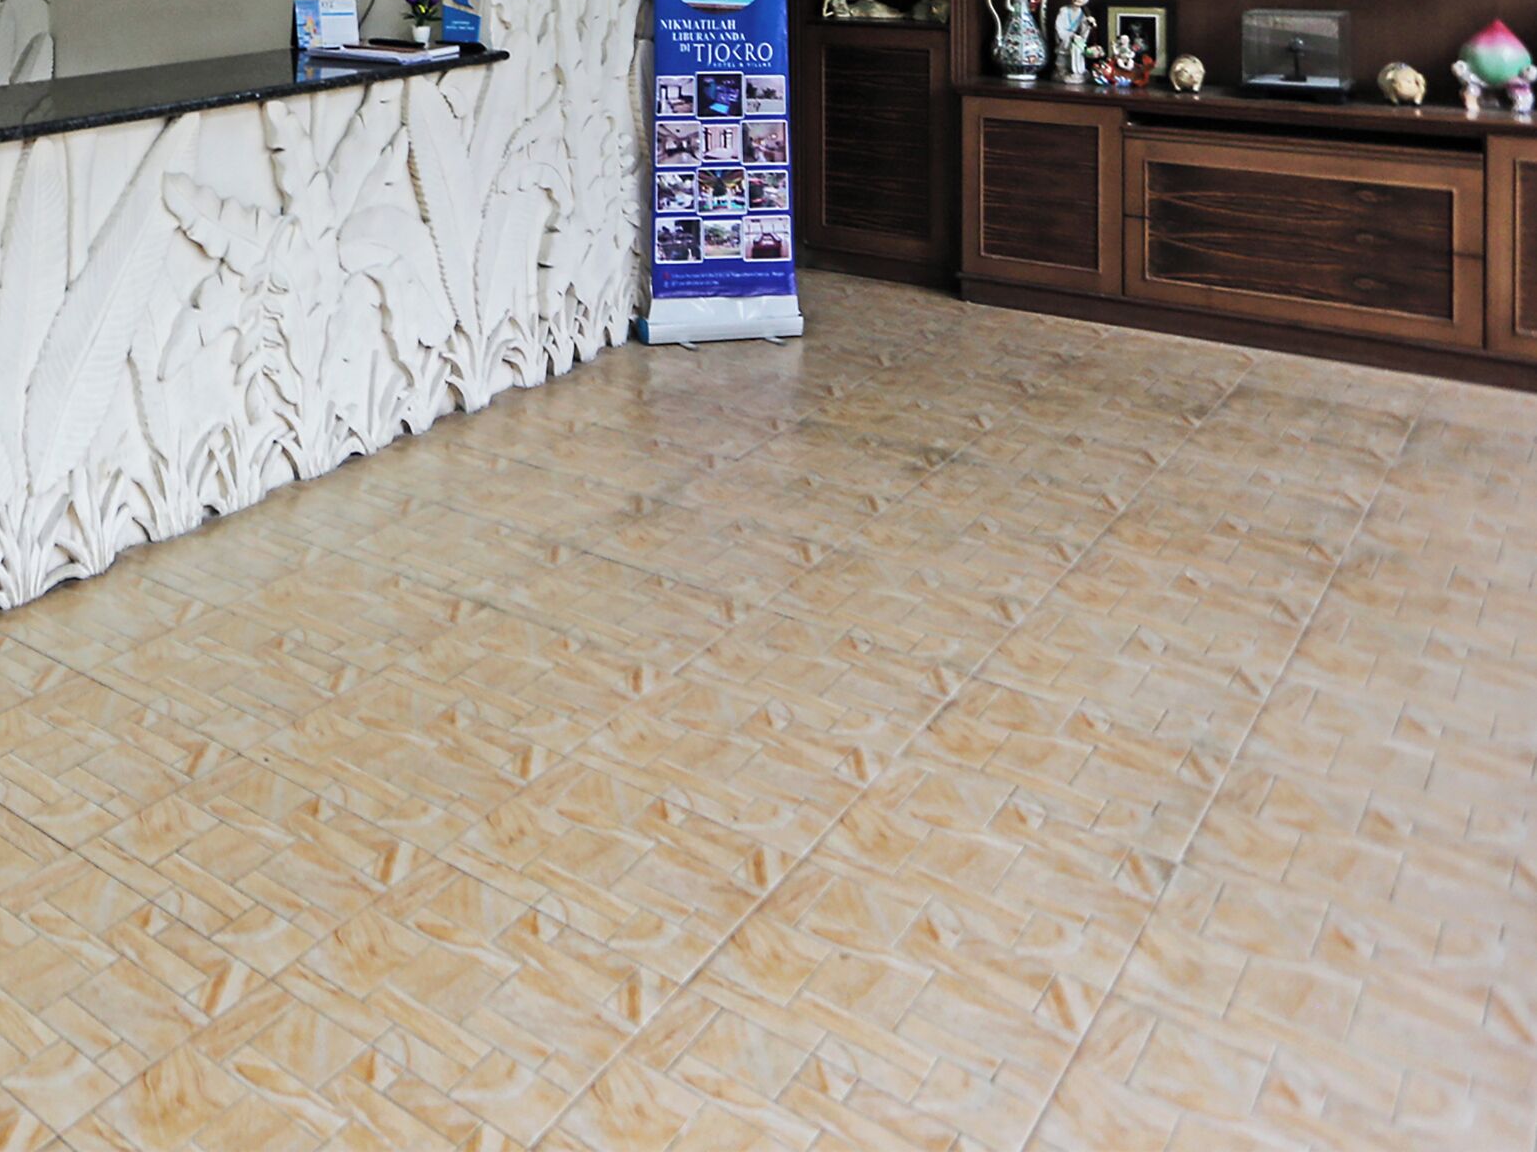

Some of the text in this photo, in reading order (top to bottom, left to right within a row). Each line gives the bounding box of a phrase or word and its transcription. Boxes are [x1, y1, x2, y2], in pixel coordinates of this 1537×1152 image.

[660, 19, 736, 30] NIKMATILAH
[672, 32, 746, 41] LIBURAN ANDA
[679, 43, 691, 52] DI
